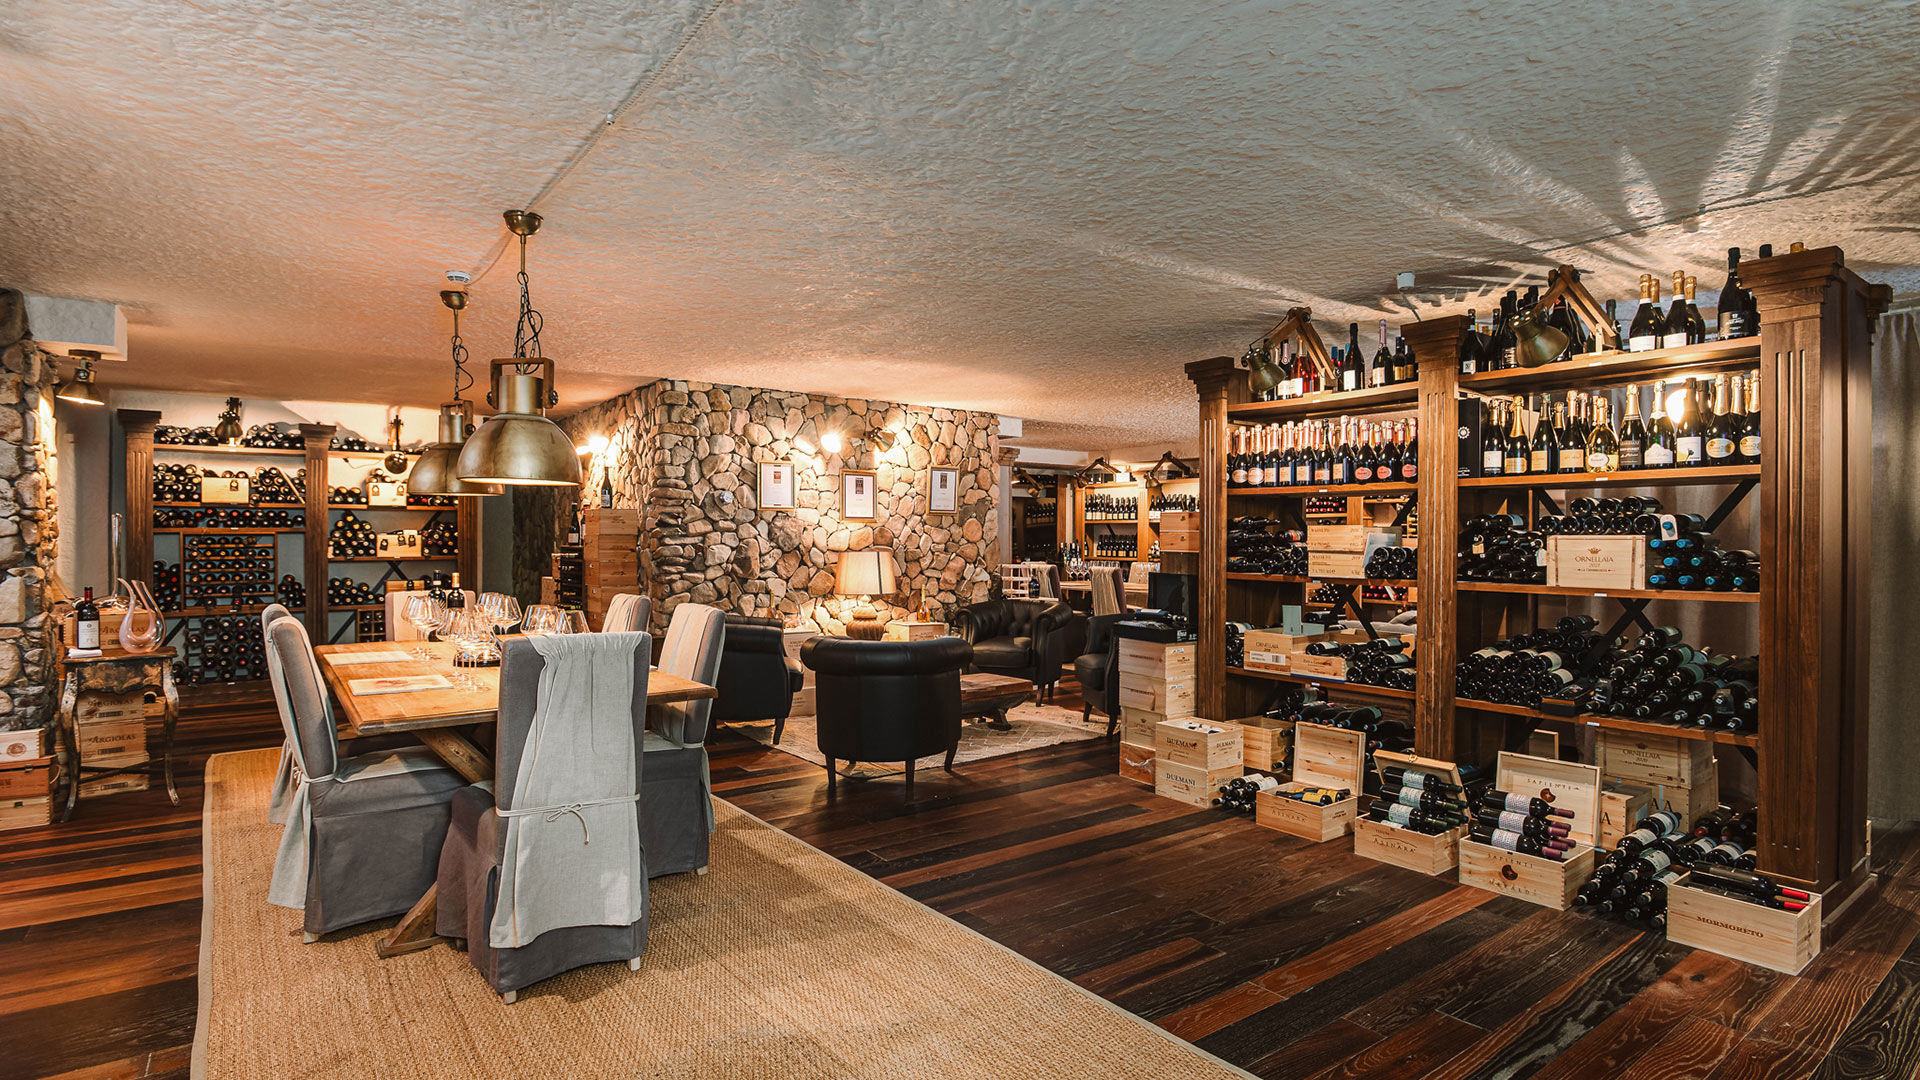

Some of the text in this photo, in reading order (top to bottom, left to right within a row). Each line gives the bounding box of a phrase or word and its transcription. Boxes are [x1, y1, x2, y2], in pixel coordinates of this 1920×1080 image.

[1574, 555, 1614, 563] ORNELLAIA
[88, 734, 137, 743] ARGIOLAS
[1622, 749, 1661, 760] ORNELLAIA
[1166, 772, 1196, 786] DUEMANI
[1373, 838, 1415, 854] ASINARA
[1696, 916, 1764, 938] MORMORETO
